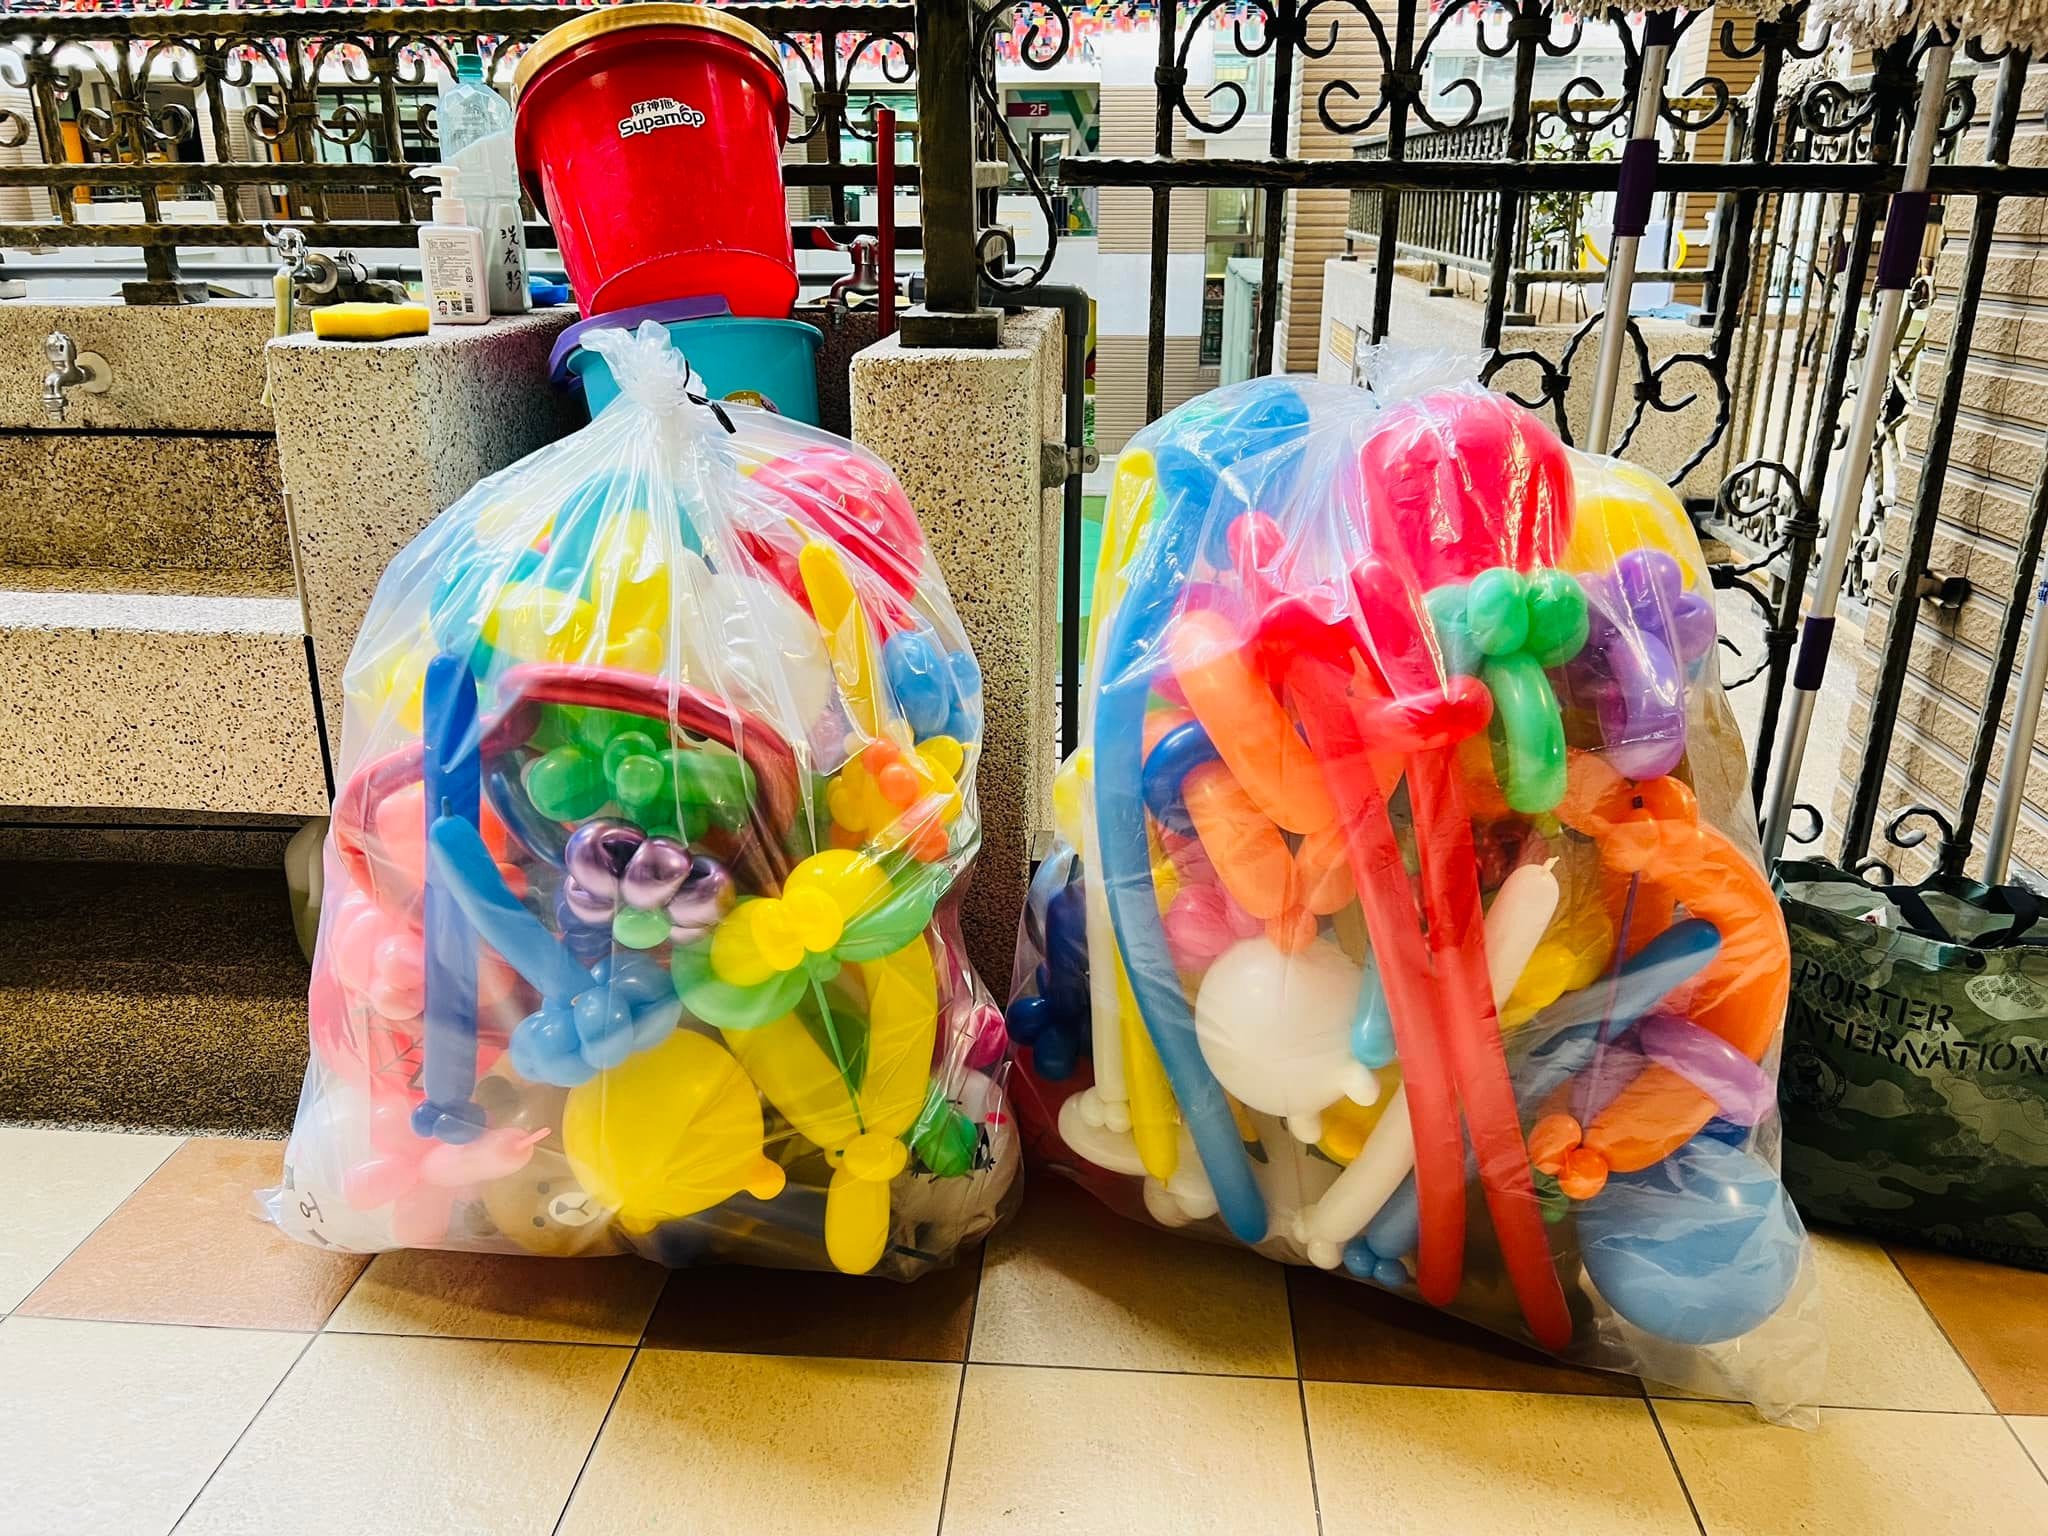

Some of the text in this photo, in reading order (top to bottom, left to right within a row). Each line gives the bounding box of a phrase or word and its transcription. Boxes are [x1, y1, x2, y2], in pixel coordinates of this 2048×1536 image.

[620, 106, 704, 135] Supamop
[633, 99, 674, 116] 好神拖
[1030, 104, 1047, 115] 2F
[500, 225, 522, 294] 洗衣粉
[1797, 959, 1954, 1031] PORTER
